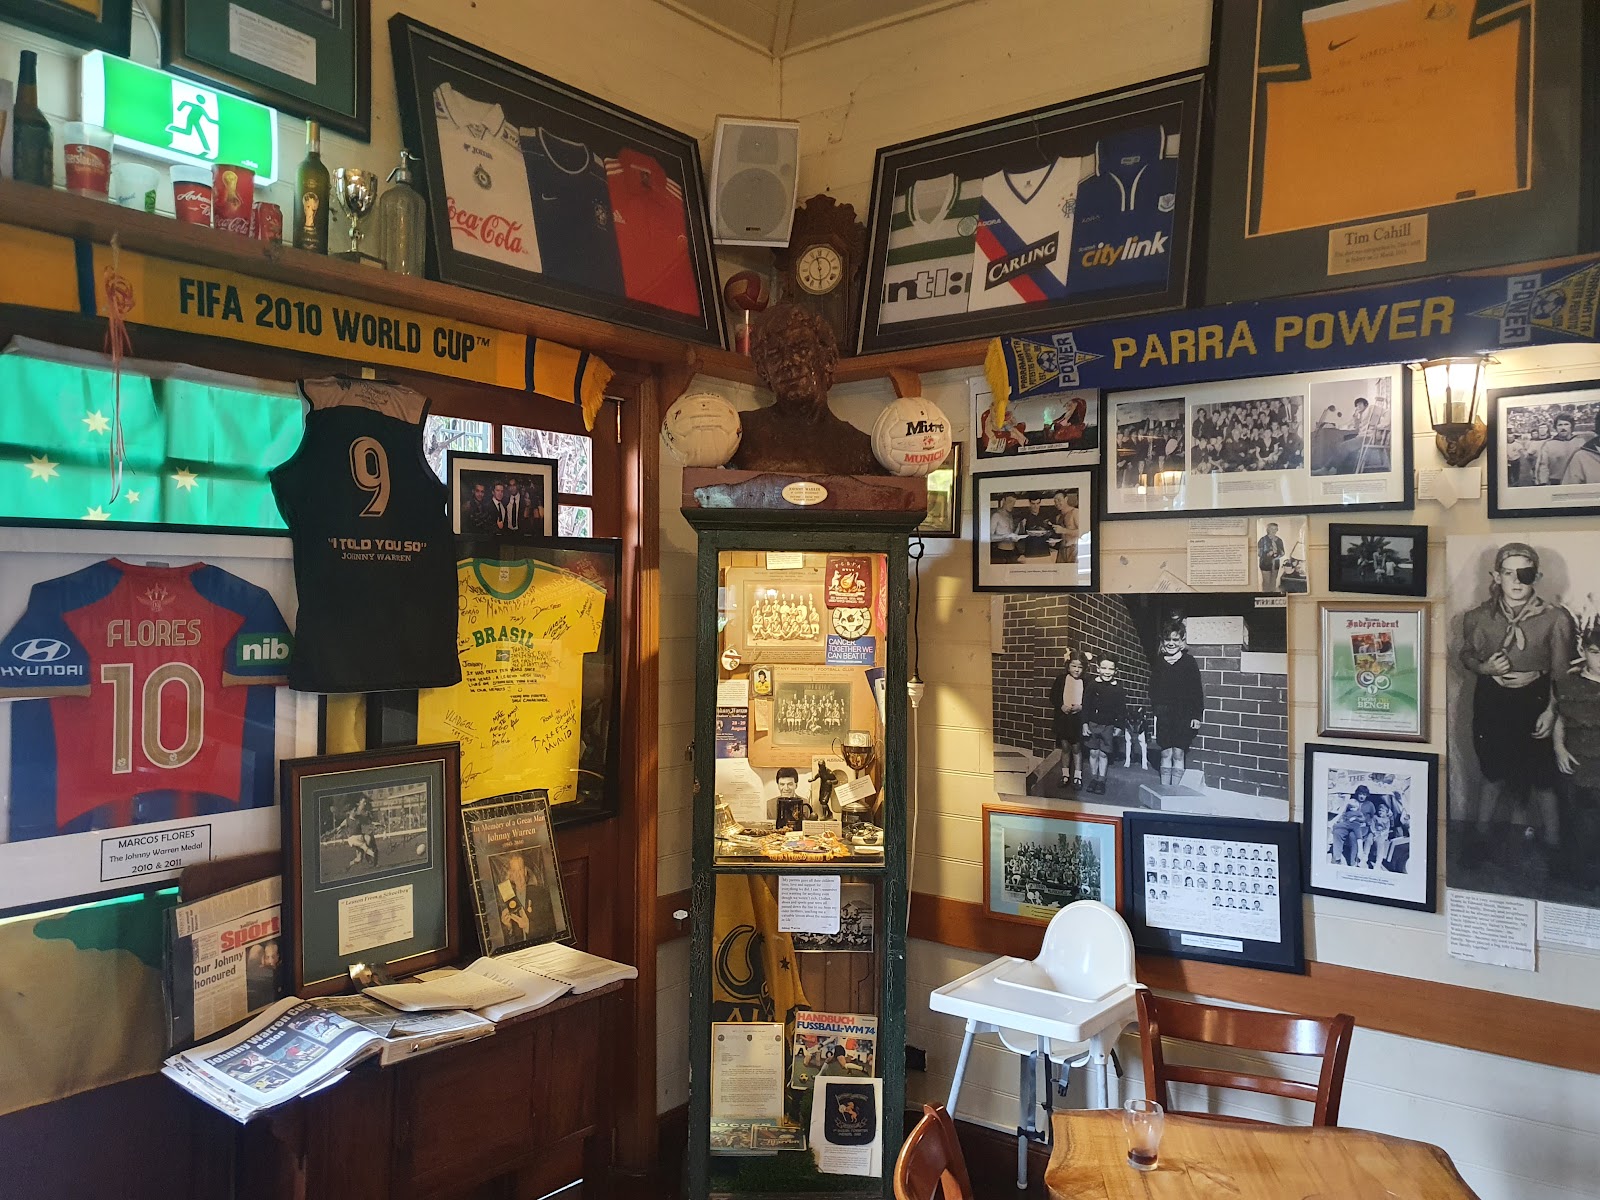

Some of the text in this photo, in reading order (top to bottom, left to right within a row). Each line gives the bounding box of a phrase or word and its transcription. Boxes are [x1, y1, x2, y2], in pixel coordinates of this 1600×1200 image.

[1345, 223, 1411, 246] Tim Cahill
[1082, 231, 1169, 267] citylink
[988, 241, 1056, 283] CARLING
[179, 278, 243, 323] FIFA
[256, 293, 322, 336] 2010
[333, 307, 421, 354] WORLD
[1505, 280, 1536, 339] POWER
[1111, 296, 1455, 370] PARRA POWER
[1014, 340, 1027, 389] PARRAMATTA
[1056, 337, 1077, 384] POWER
[906, 421, 944, 437] Mitre
[904, 449, 945, 463] MUNICH
[349, 436, 391, 518] 9
[340, 538, 372, 551] TOLD
[375, 540, 403, 551] YOU
[404, 541, 427, 553] SO"
[341, 553, 412, 562] JOHNNY WARREN
[107, 619, 201, 648] FLORES
[1346, 619, 1399, 630] Independent
[472, 625, 534, 649] BRASIL
[242, 638, 290, 661] nib
[827, 652, 843, 660] CAN
[828, 645, 862, 653] TOGETHER
[0, 665, 83, 677] HYUNDAI
[1357, 701, 1390, 709] BENCH
[101, 661, 205, 775] 10
[1349, 774, 1366, 783] THE
[473, 825, 480, 833] In
[481, 822, 505, 832] Memory
[505, 820, 511, 828] of
[516, 817, 533, 826] Great
[533, 814, 546, 823] Man
[118, 830, 195, 849] MARCOS FLORES
[487, 828, 536, 844] Johnny Warren
[109, 842, 203, 863] The Johnny Warren Medal
[131, 858, 182, 874] 2010 & 2011
[220, 916, 280, 949] Sport
[194, 951, 244, 977] Our Johnny
[194, 965, 236, 990] honoured
[797, 1012, 855, 1025] HANDBUCH
[797, 1021, 875, 1035] FUSSBALL-WM 74
[205, 1002, 313, 1067] Johnny Warren Cup
[256, 1030, 287, 1051] Action
